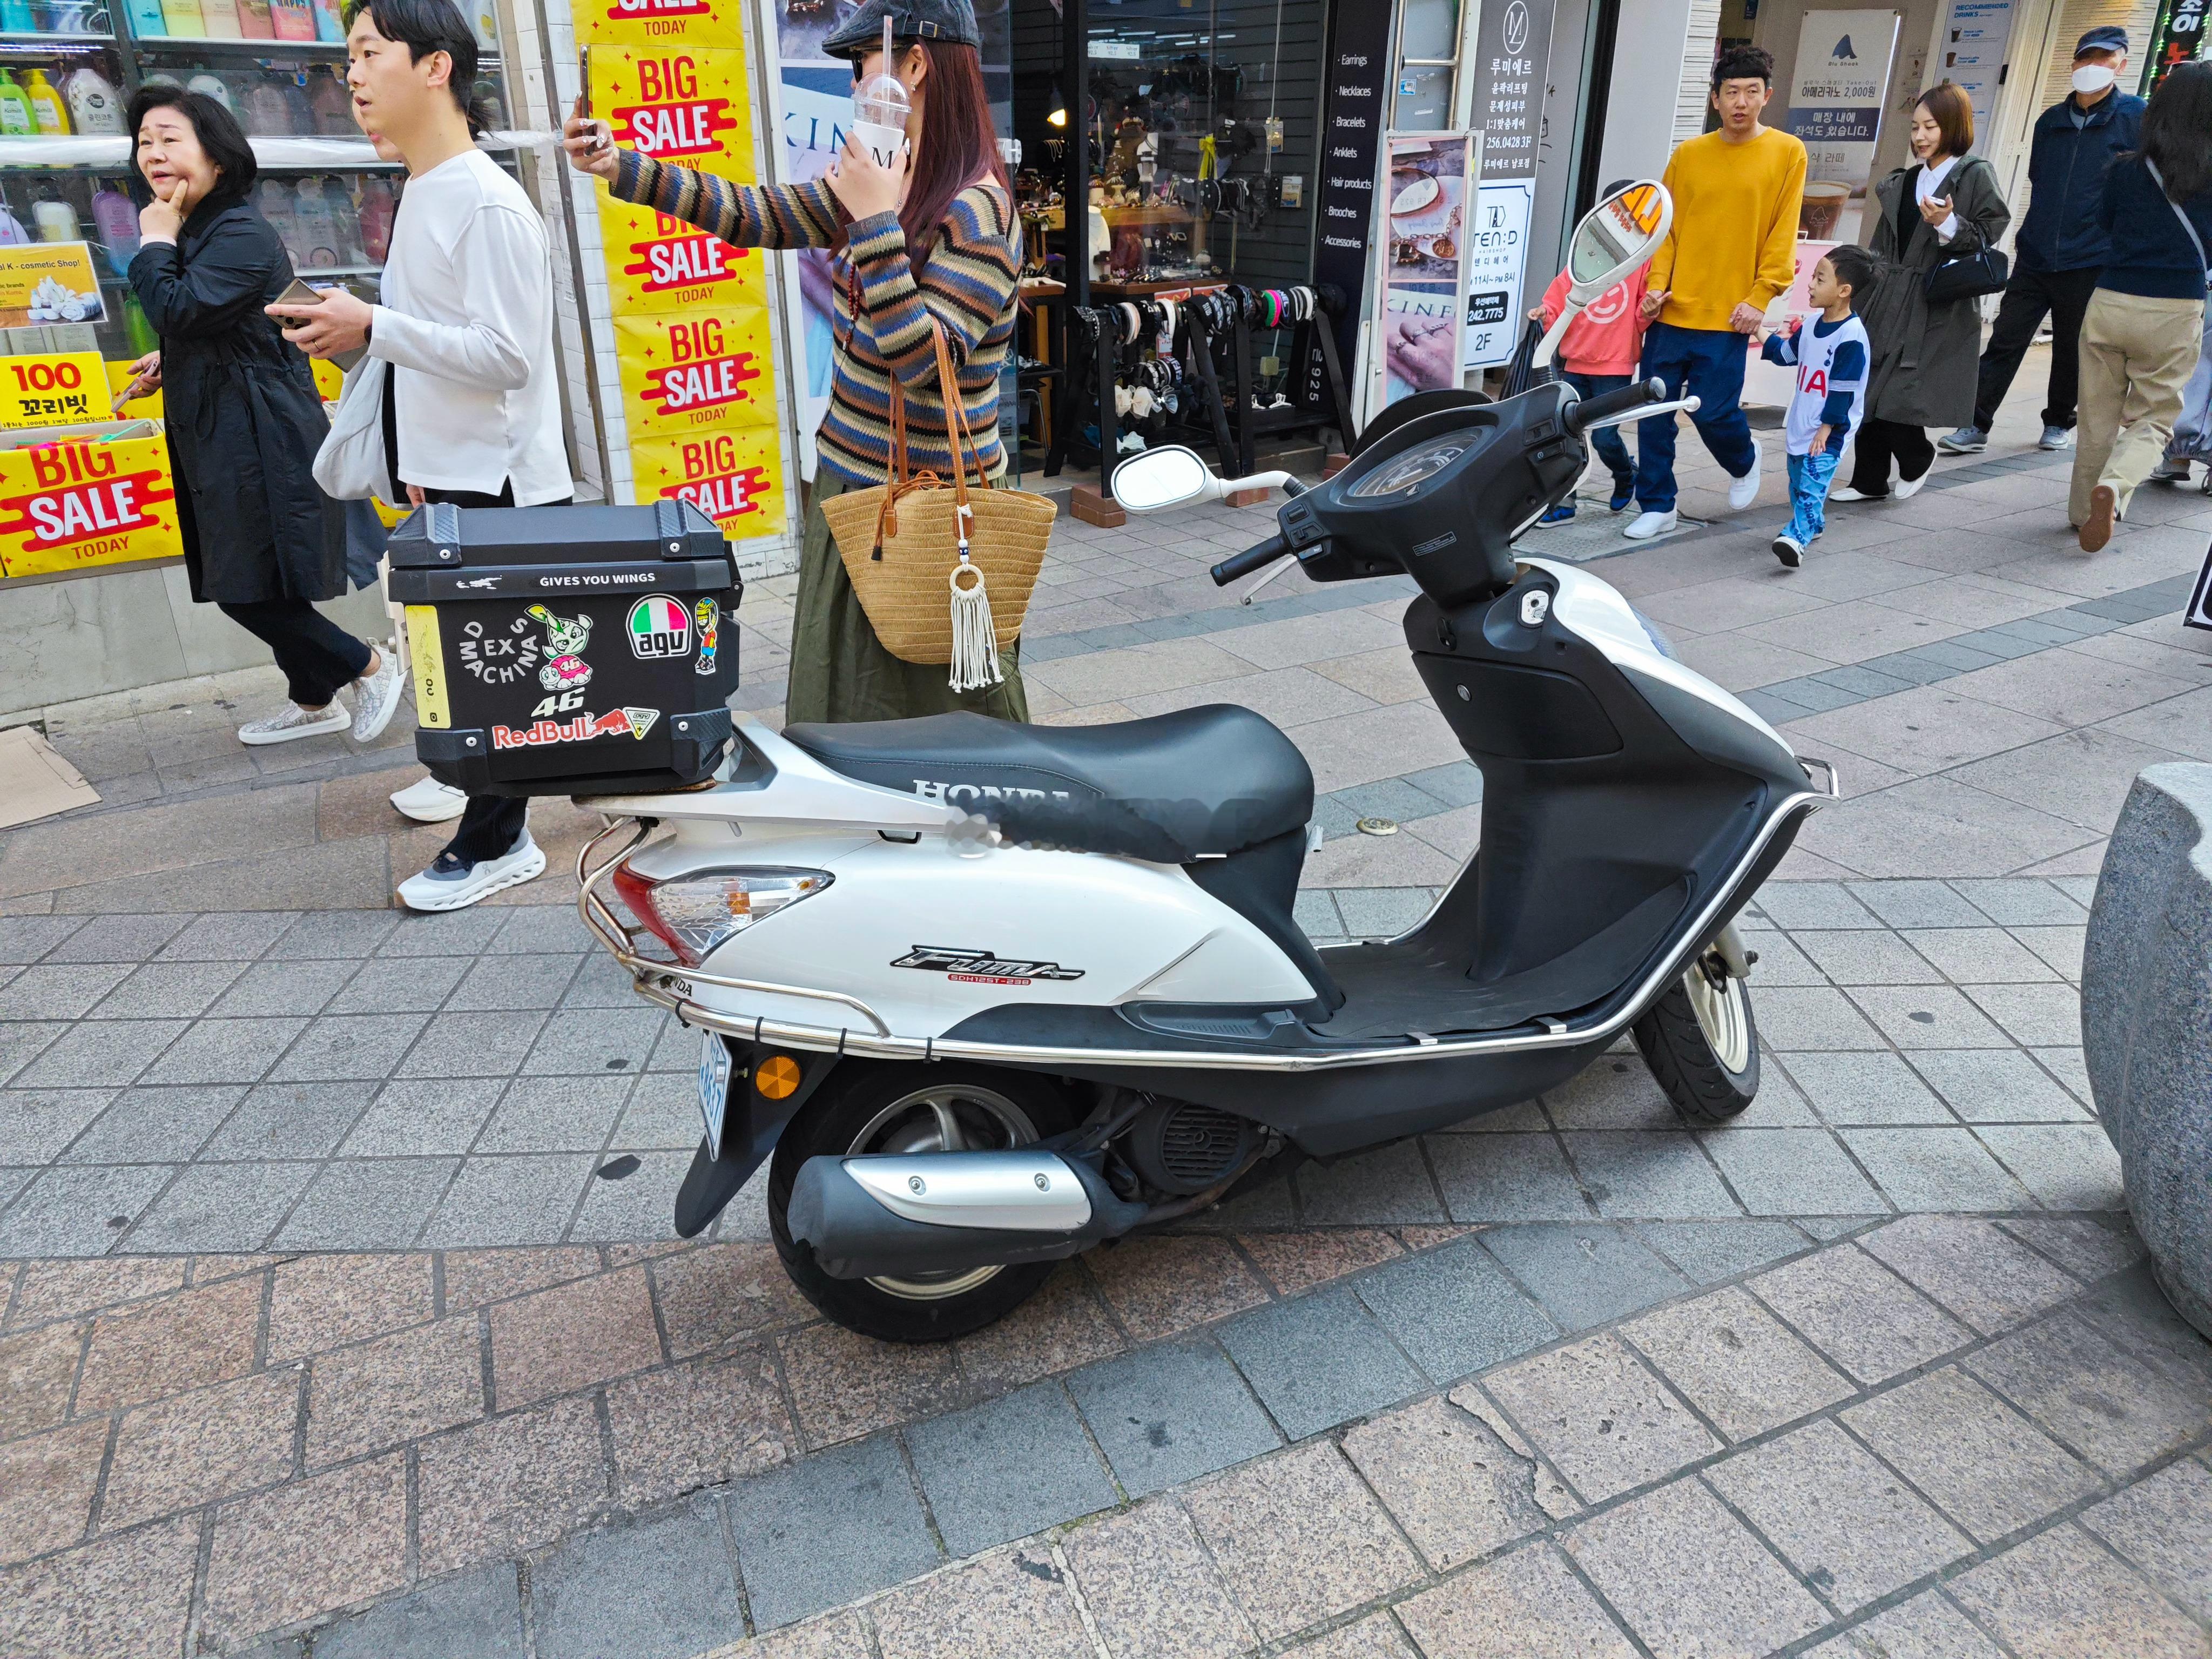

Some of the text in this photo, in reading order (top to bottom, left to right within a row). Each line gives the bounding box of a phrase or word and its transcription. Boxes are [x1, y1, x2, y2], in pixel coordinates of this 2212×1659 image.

[1955, 3, 2009, 11] RECOMMENDED
[643, 19, 687, 36] TODAY
[1341, 54, 1367, 66] Earrings
[1490, 58, 1532, 76] 루미에르
[637, 56, 698, 102] BIG
[1339, 85, 1372, 96] Necklaces
[1491, 82, 1528, 95] 윤곽리프팅
[1802, 86, 1876, 99] 아메리카노 2,000원
[1489, 100, 1526, 113] 문제성피부
[1336, 116, 1366, 127] Bracelets
[1486, 118, 1526, 131] 1:1맞춤케어
[1812, 112, 1856, 123] 매장 내에
[632, 105, 712, 152] SALE
[1794, 125, 1870, 138] 좌석도 있습니다.
[1486, 136, 1532, 149] 256.0428 3F
[1333, 147, 1358, 158] Anklets
[1825, 152, 1845, 163] 라떼
[1483, 158, 1530, 170] 루미에르 남포점
[1331, 176, 1372, 190] Hair products
[1328, 206, 1357, 218] Brooches
[1324, 235, 1362, 248] Accessories
[21, 261, 56, 269] cosmetic
[57, 259, 80, 268] Shop!
[650, 237, 725, 285] SALE
[1504, 271, 1515, 282] 8시
[675, 286, 714, 304] TODAY
[1468, 307, 1504, 322] 242.7775
[668, 318, 725, 363] BIG
[1475, 333, 1492, 351] 2F
[10, 362, 82, 392] 100
[664, 359, 737, 407] SALE
[1309, 367, 1321, 402] 925
[18, 394, 89, 416] 꼬리빗
[687, 407, 727, 425] TODAY
[682, 435, 736, 480] BIG
[28, 442, 117, 489] BIG
[29, 480, 141, 540] SALE
[71, 535, 129, 560] TODAY
[540, 572, 656, 586] GIVES YOU WINGS
[484, 639, 515, 656] EX
[639, 631, 684, 656] agv
[559, 658, 581, 672] 46
[531, 687, 586, 718] 46
